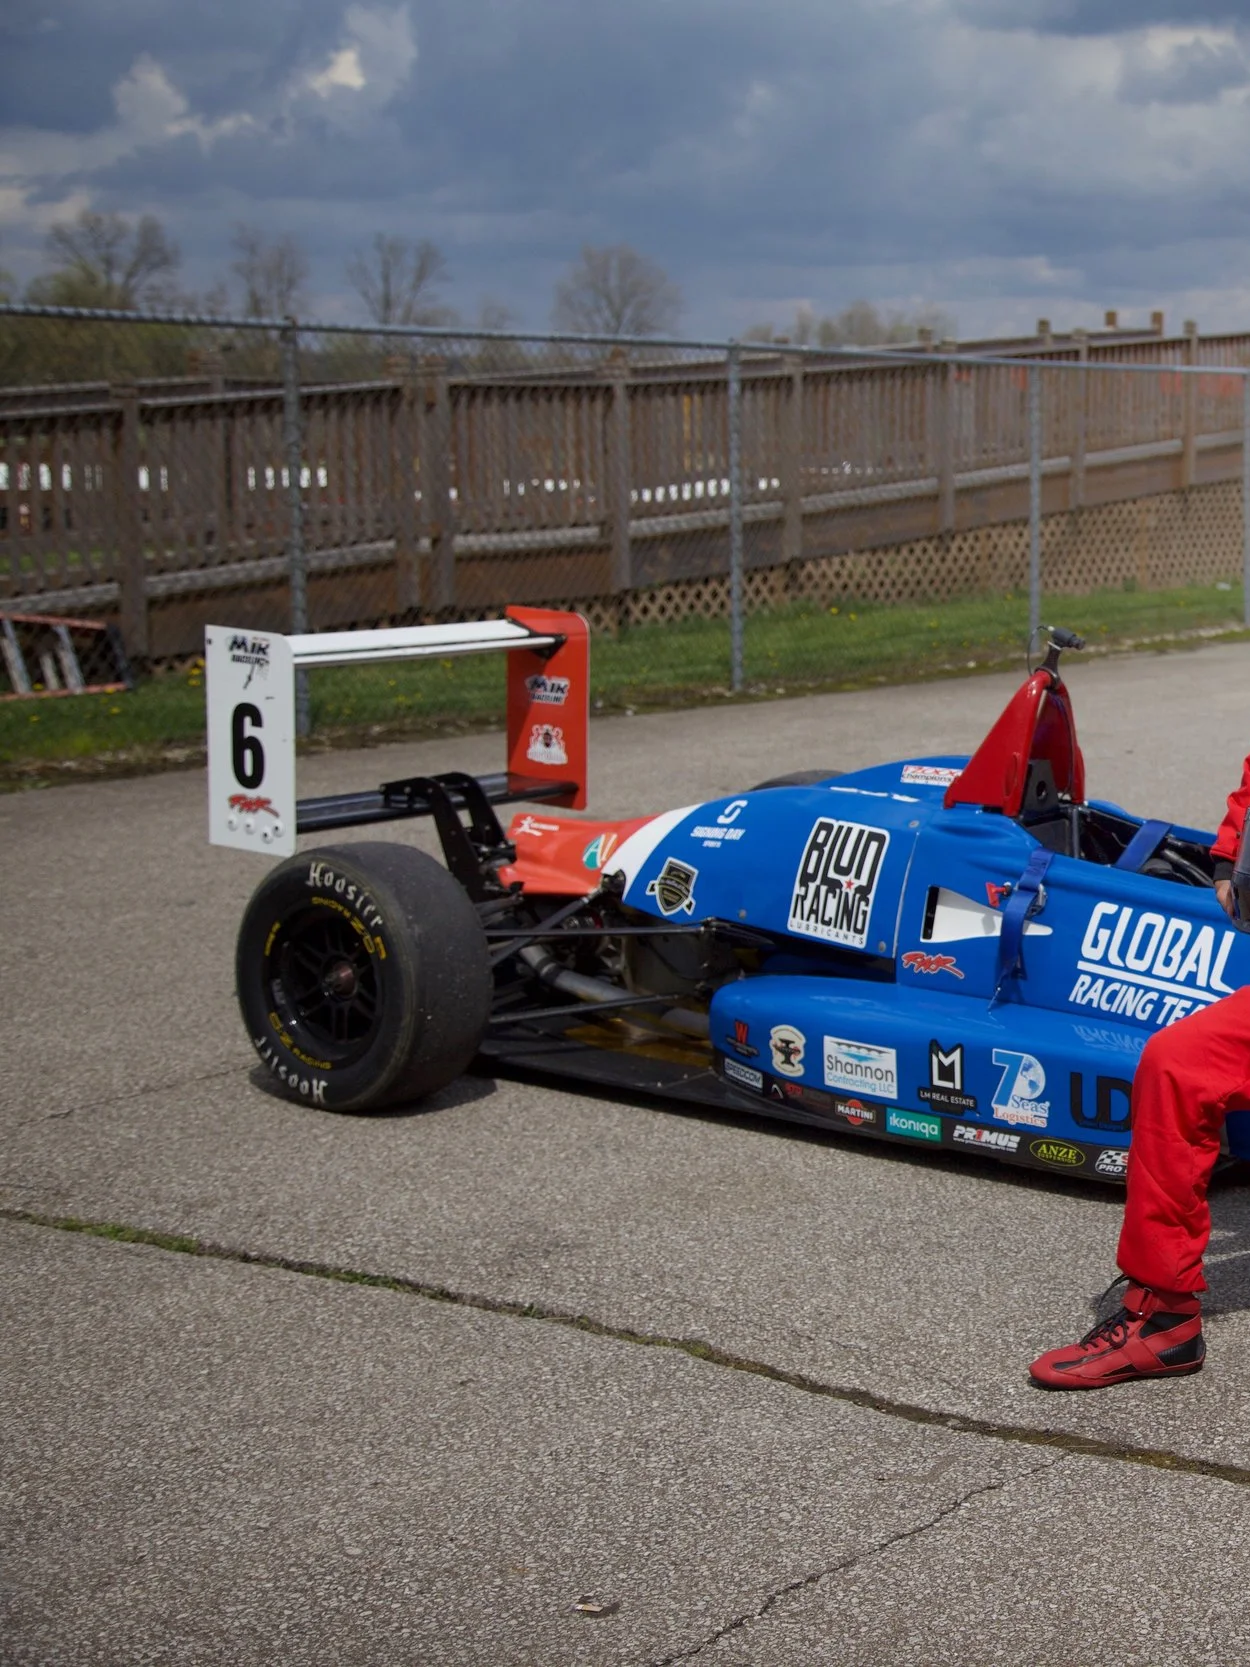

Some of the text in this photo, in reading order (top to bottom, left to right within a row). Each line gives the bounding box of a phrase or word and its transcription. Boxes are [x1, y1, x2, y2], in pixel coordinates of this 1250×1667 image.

[231, 702, 265, 789] 6
[305, 861, 384, 927] Hoosier
[792, 884, 871, 935] RACING
[789, 921, 863, 945] LUBRICANTS
[1081, 901, 1235, 994] GLOBAL
[1068, 974, 1159, 1021] RACING
[255, 1036, 328, 1103] Hoosier
[826, 1054, 894, 1083] Shannon
[826, 1072, 895, 1094] Contracting LLC
[920, 1090, 975, 1107] LM REAL ESTATE
[1011, 1095, 1048, 1115] Seas
[836, 1104, 874, 1120] MARTINI
[993, 1107, 1047, 1127] Logistics
[889, 1112, 939, 1137] ikoniqa
[1037, 1144, 1077, 1160] ANZE
[1098, 1164, 1123, 1173] PRO
